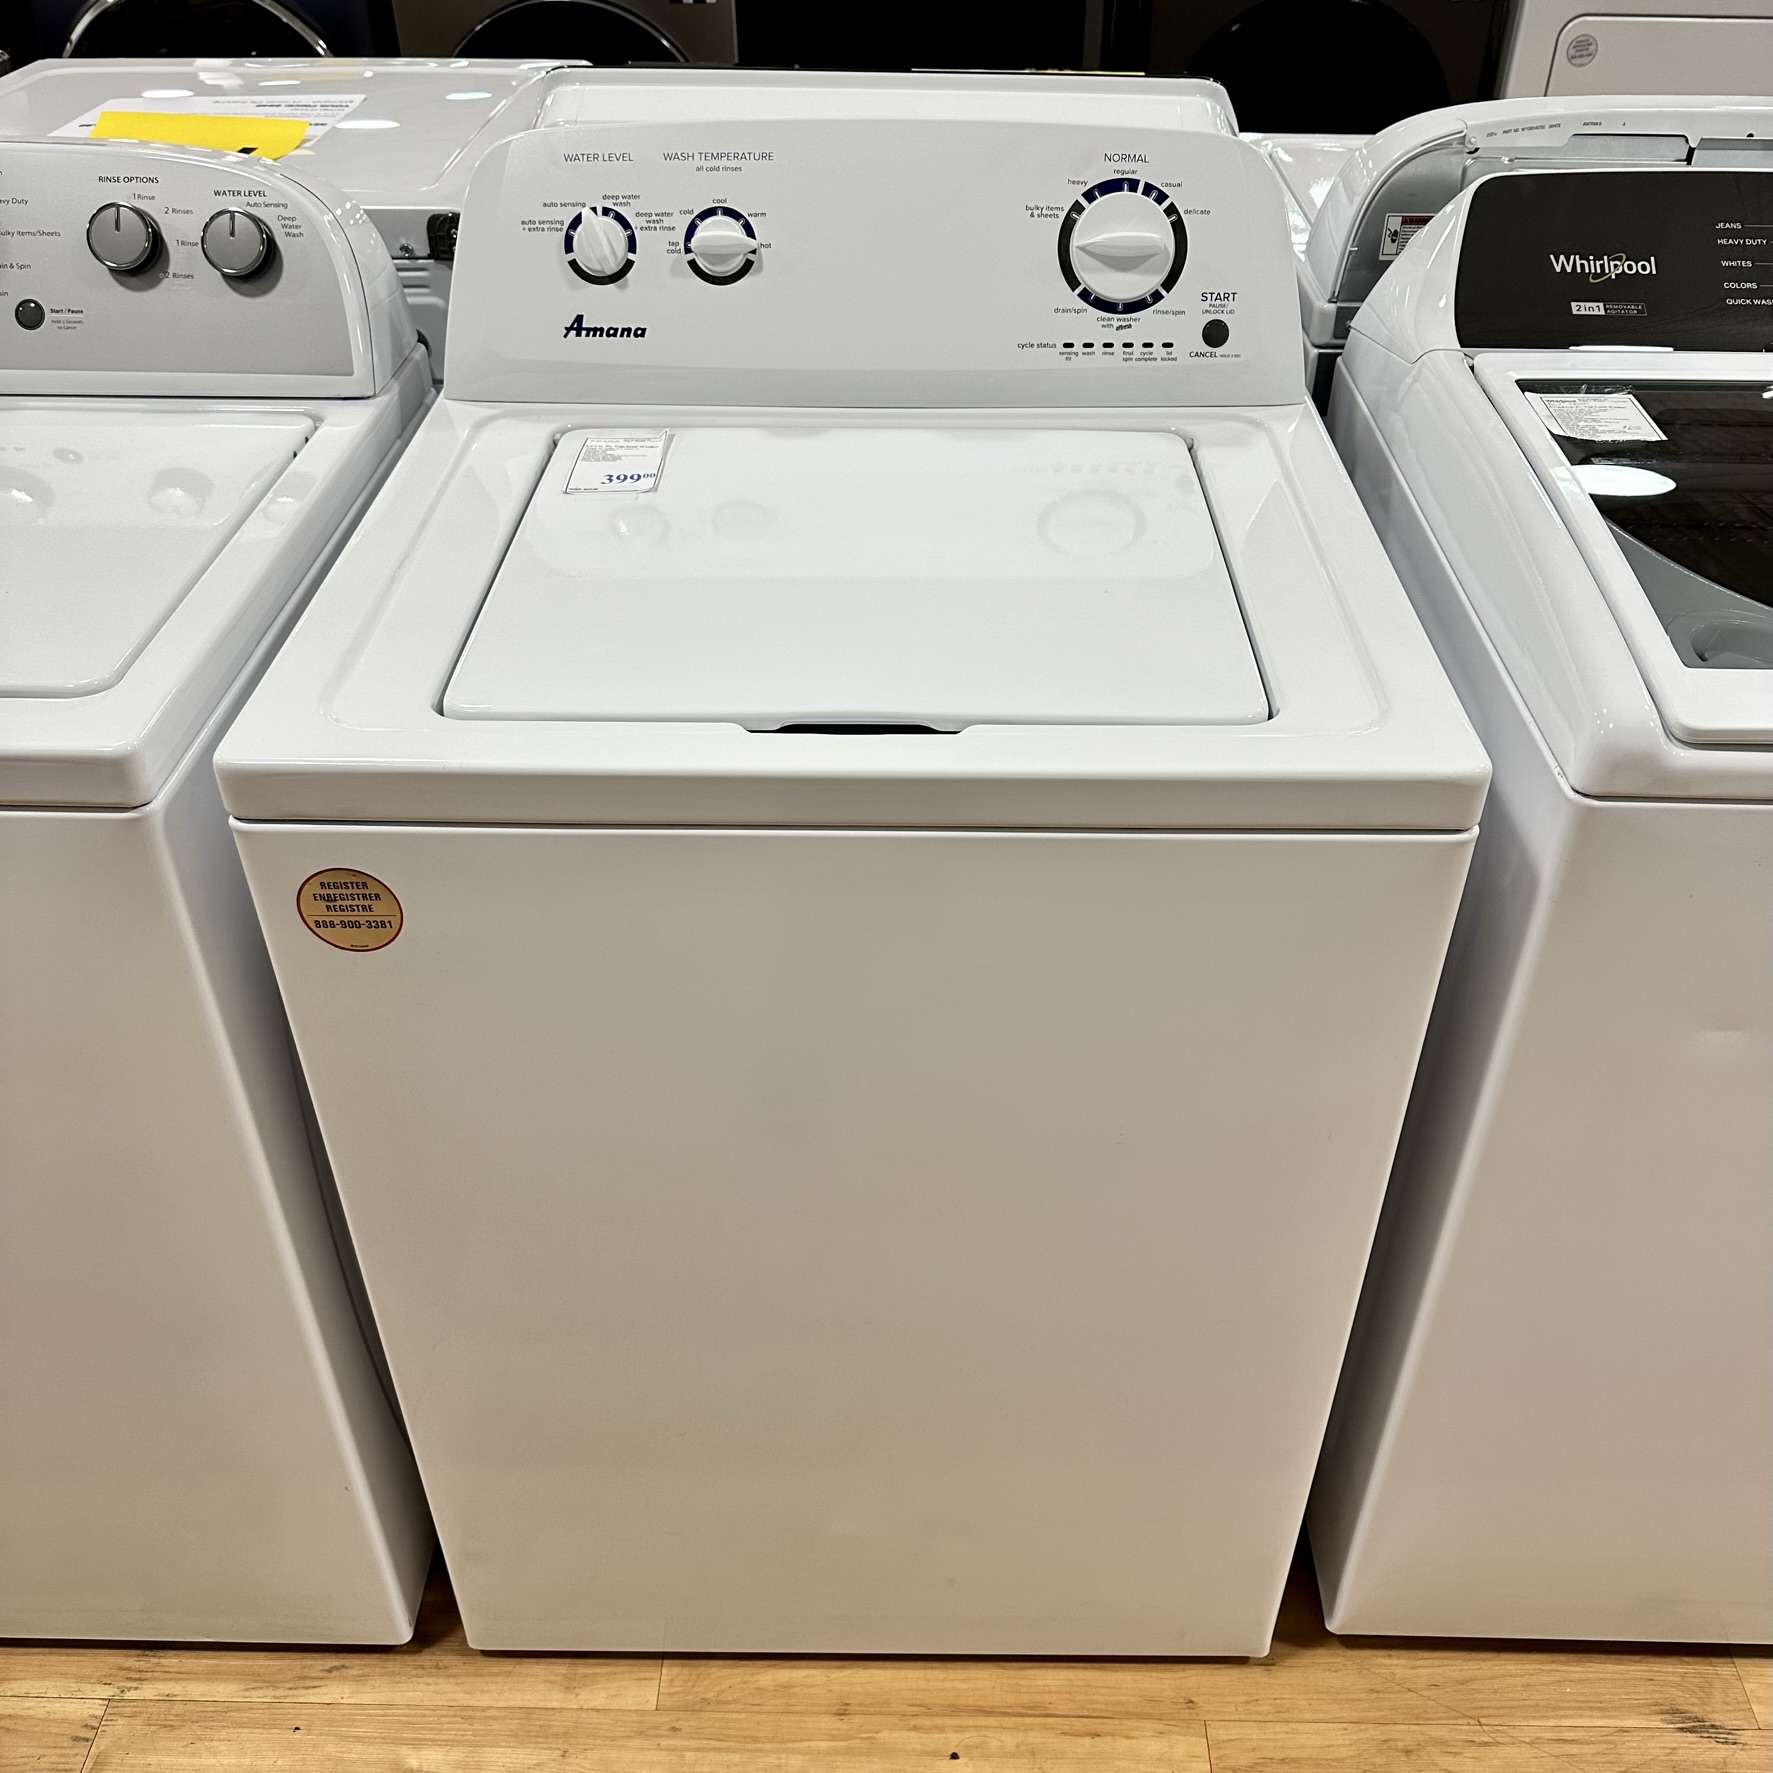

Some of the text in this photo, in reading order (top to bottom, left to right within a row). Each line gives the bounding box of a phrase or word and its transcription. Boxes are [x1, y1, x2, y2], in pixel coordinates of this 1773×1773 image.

[564, 152, 634, 162] WATER LEVEL
[663, 152, 774, 161] WASH TEMPERATURE
[1104, 153, 1149, 163] NORMAL
[123, 176, 159, 184] OPTIONS
[1026, 205, 1044, 213] bulky
[278, 215, 297, 223] Deep
[668, 240, 680, 248] tap
[1550, 254, 1656, 279] Whirlpool
[1201, 293, 1237, 302] START
[563, 314, 647, 338] Amana
[313, 893, 381, 901] ENREGISTRER
[314, 920, 393, 929] 888-900-3381
